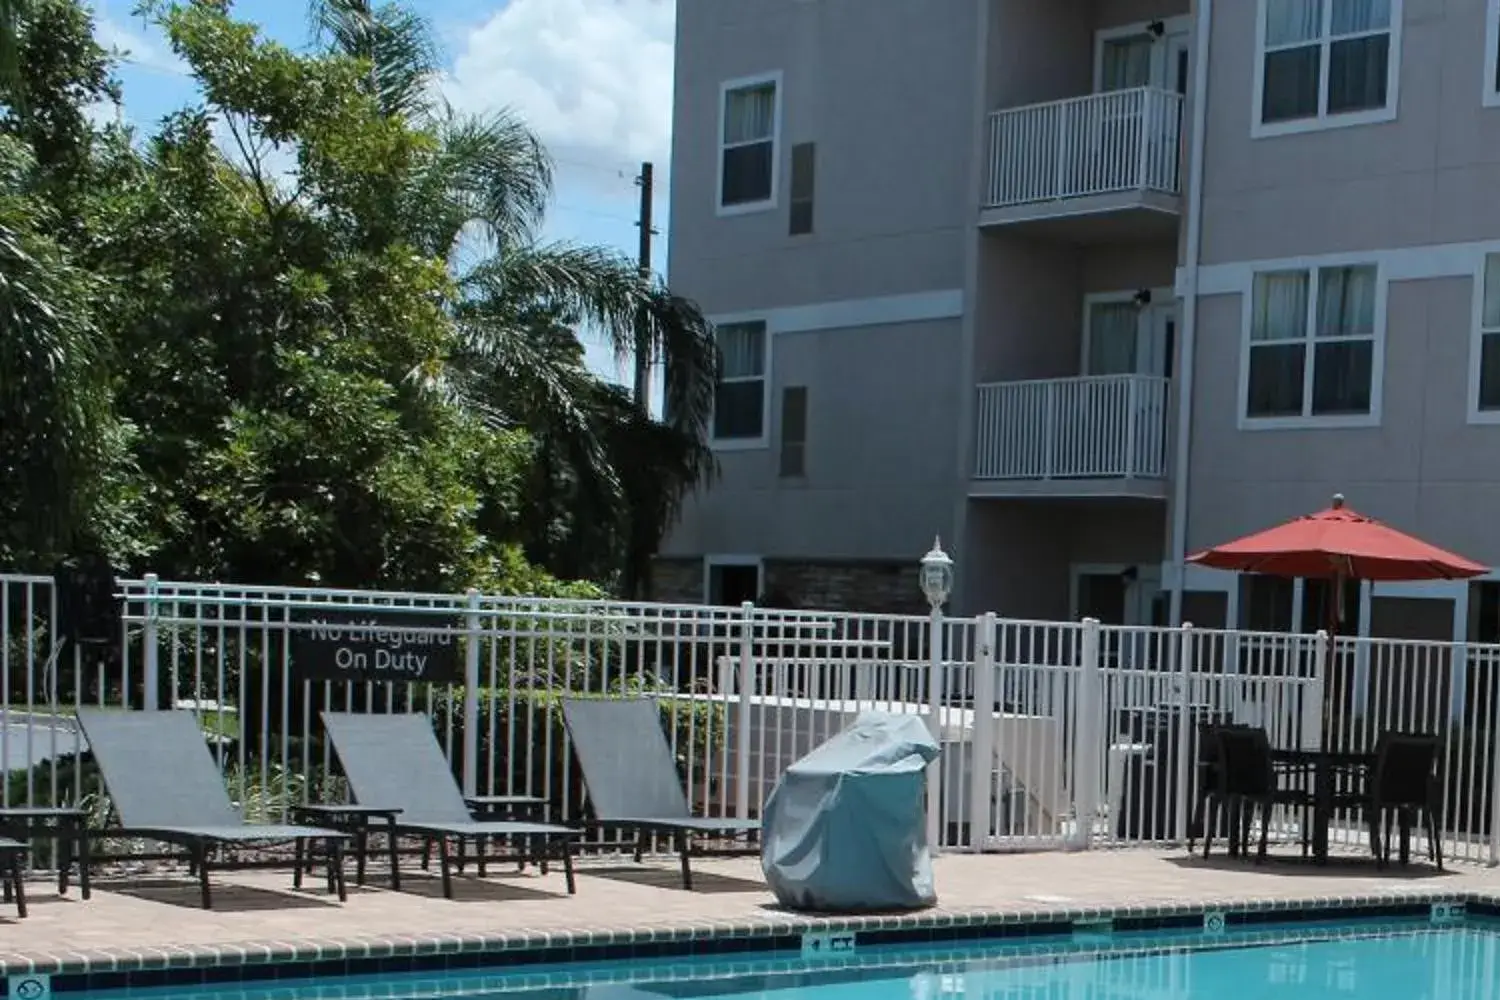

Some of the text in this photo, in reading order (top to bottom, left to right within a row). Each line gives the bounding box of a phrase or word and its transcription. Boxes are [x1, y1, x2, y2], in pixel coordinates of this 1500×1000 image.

[311, 619, 452, 649] No Lifeguard
[335, 648, 427, 676] On Duty
